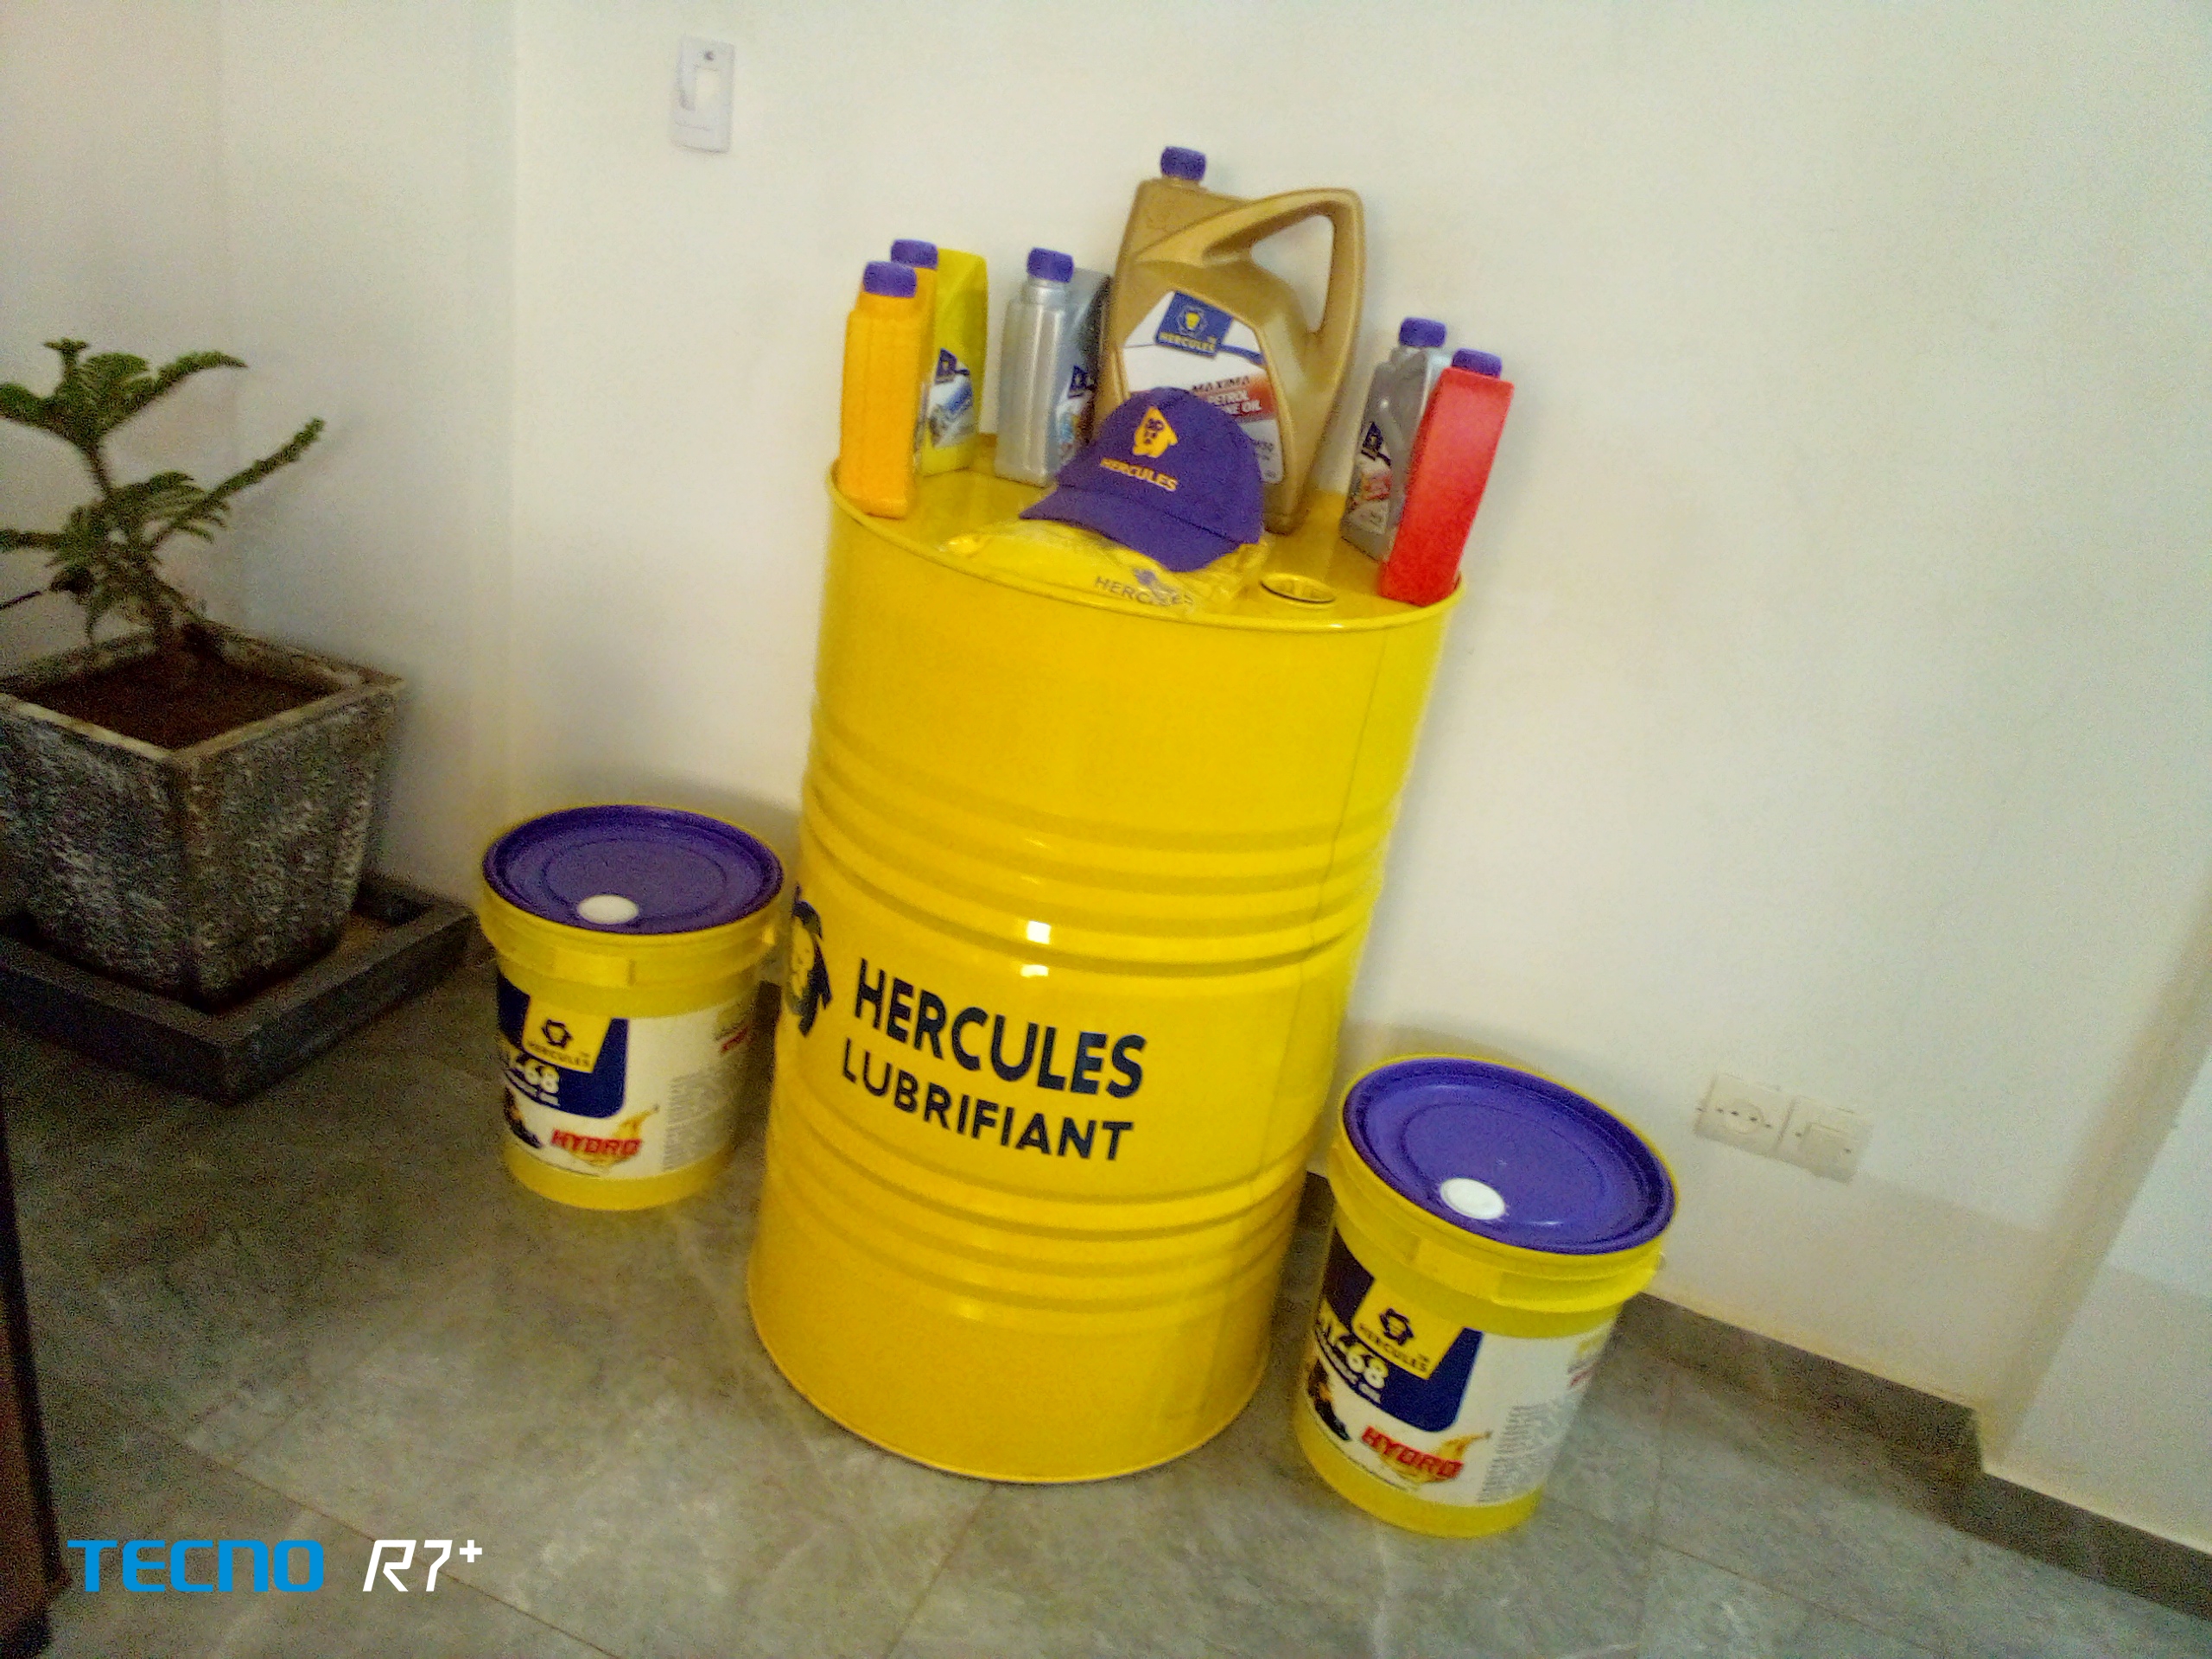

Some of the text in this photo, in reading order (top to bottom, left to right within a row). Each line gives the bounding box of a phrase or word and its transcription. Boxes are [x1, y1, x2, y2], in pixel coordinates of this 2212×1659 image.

[1100, 457, 1179, 492] HERCULES
[854, 957, 1147, 1099] HERCULES
[841, 1037, 1135, 1161] LUBRIFIANT
[550, 1128, 643, 1158] HYDRO
[1361, 1425, 1465, 1480] HYDRO
